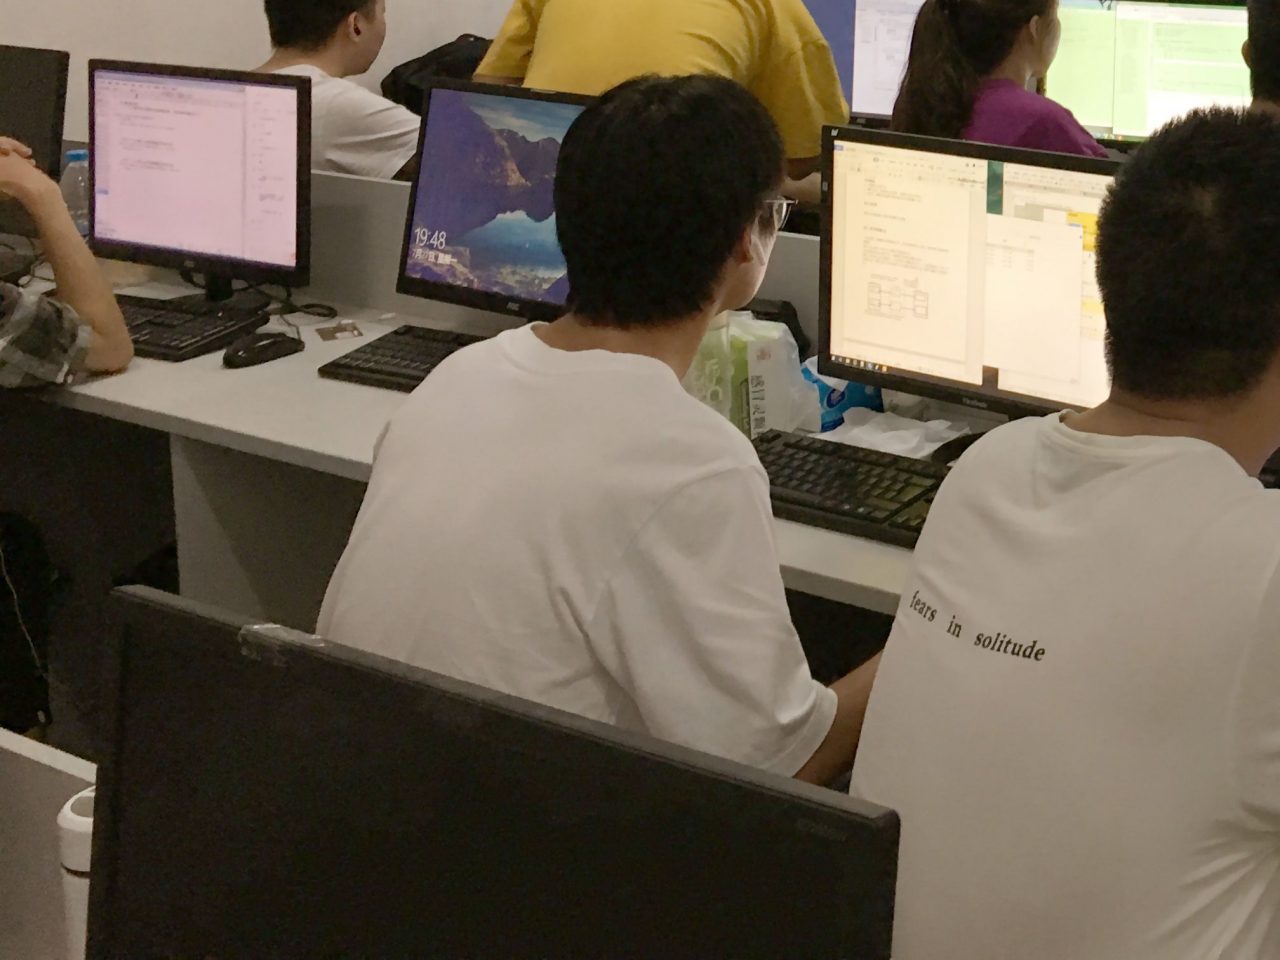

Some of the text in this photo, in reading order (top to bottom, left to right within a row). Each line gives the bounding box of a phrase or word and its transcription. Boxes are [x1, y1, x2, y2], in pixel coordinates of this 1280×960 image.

[414, 226, 447, 250] 19:48
[909, 590, 1046, 662] fears in solitude
